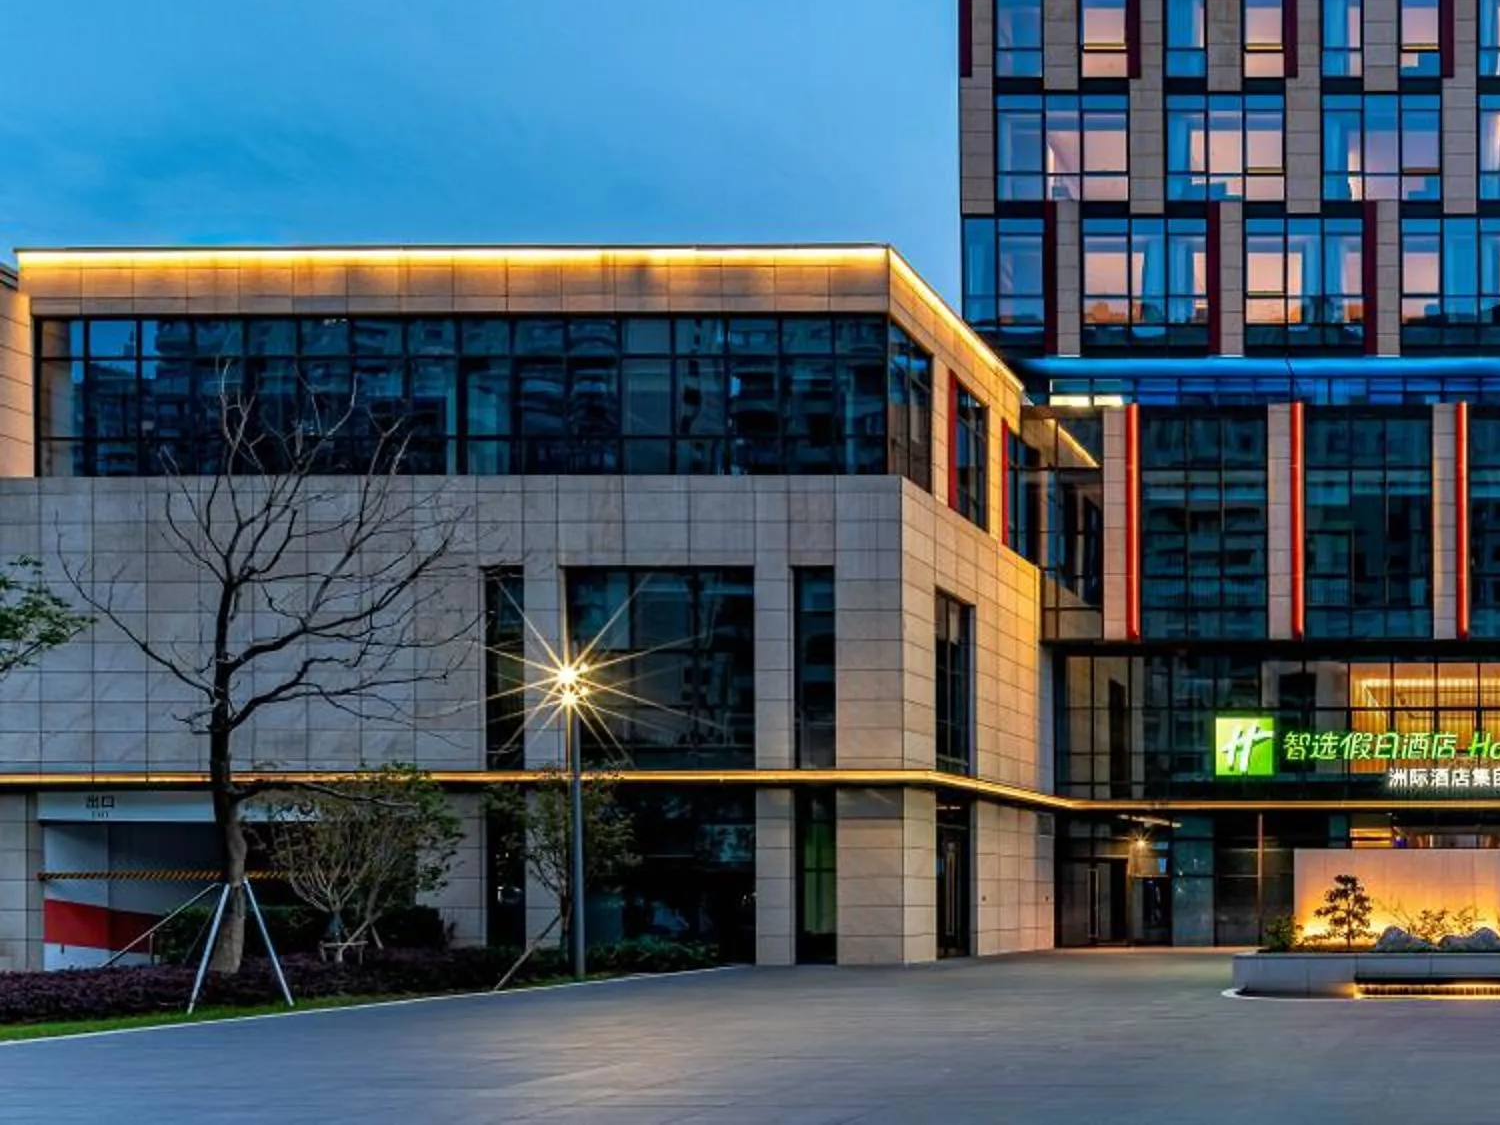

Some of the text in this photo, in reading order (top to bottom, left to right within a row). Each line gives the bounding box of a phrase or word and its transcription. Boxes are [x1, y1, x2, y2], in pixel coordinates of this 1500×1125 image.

[1283, 731, 1457, 760] 智选假日酒店
